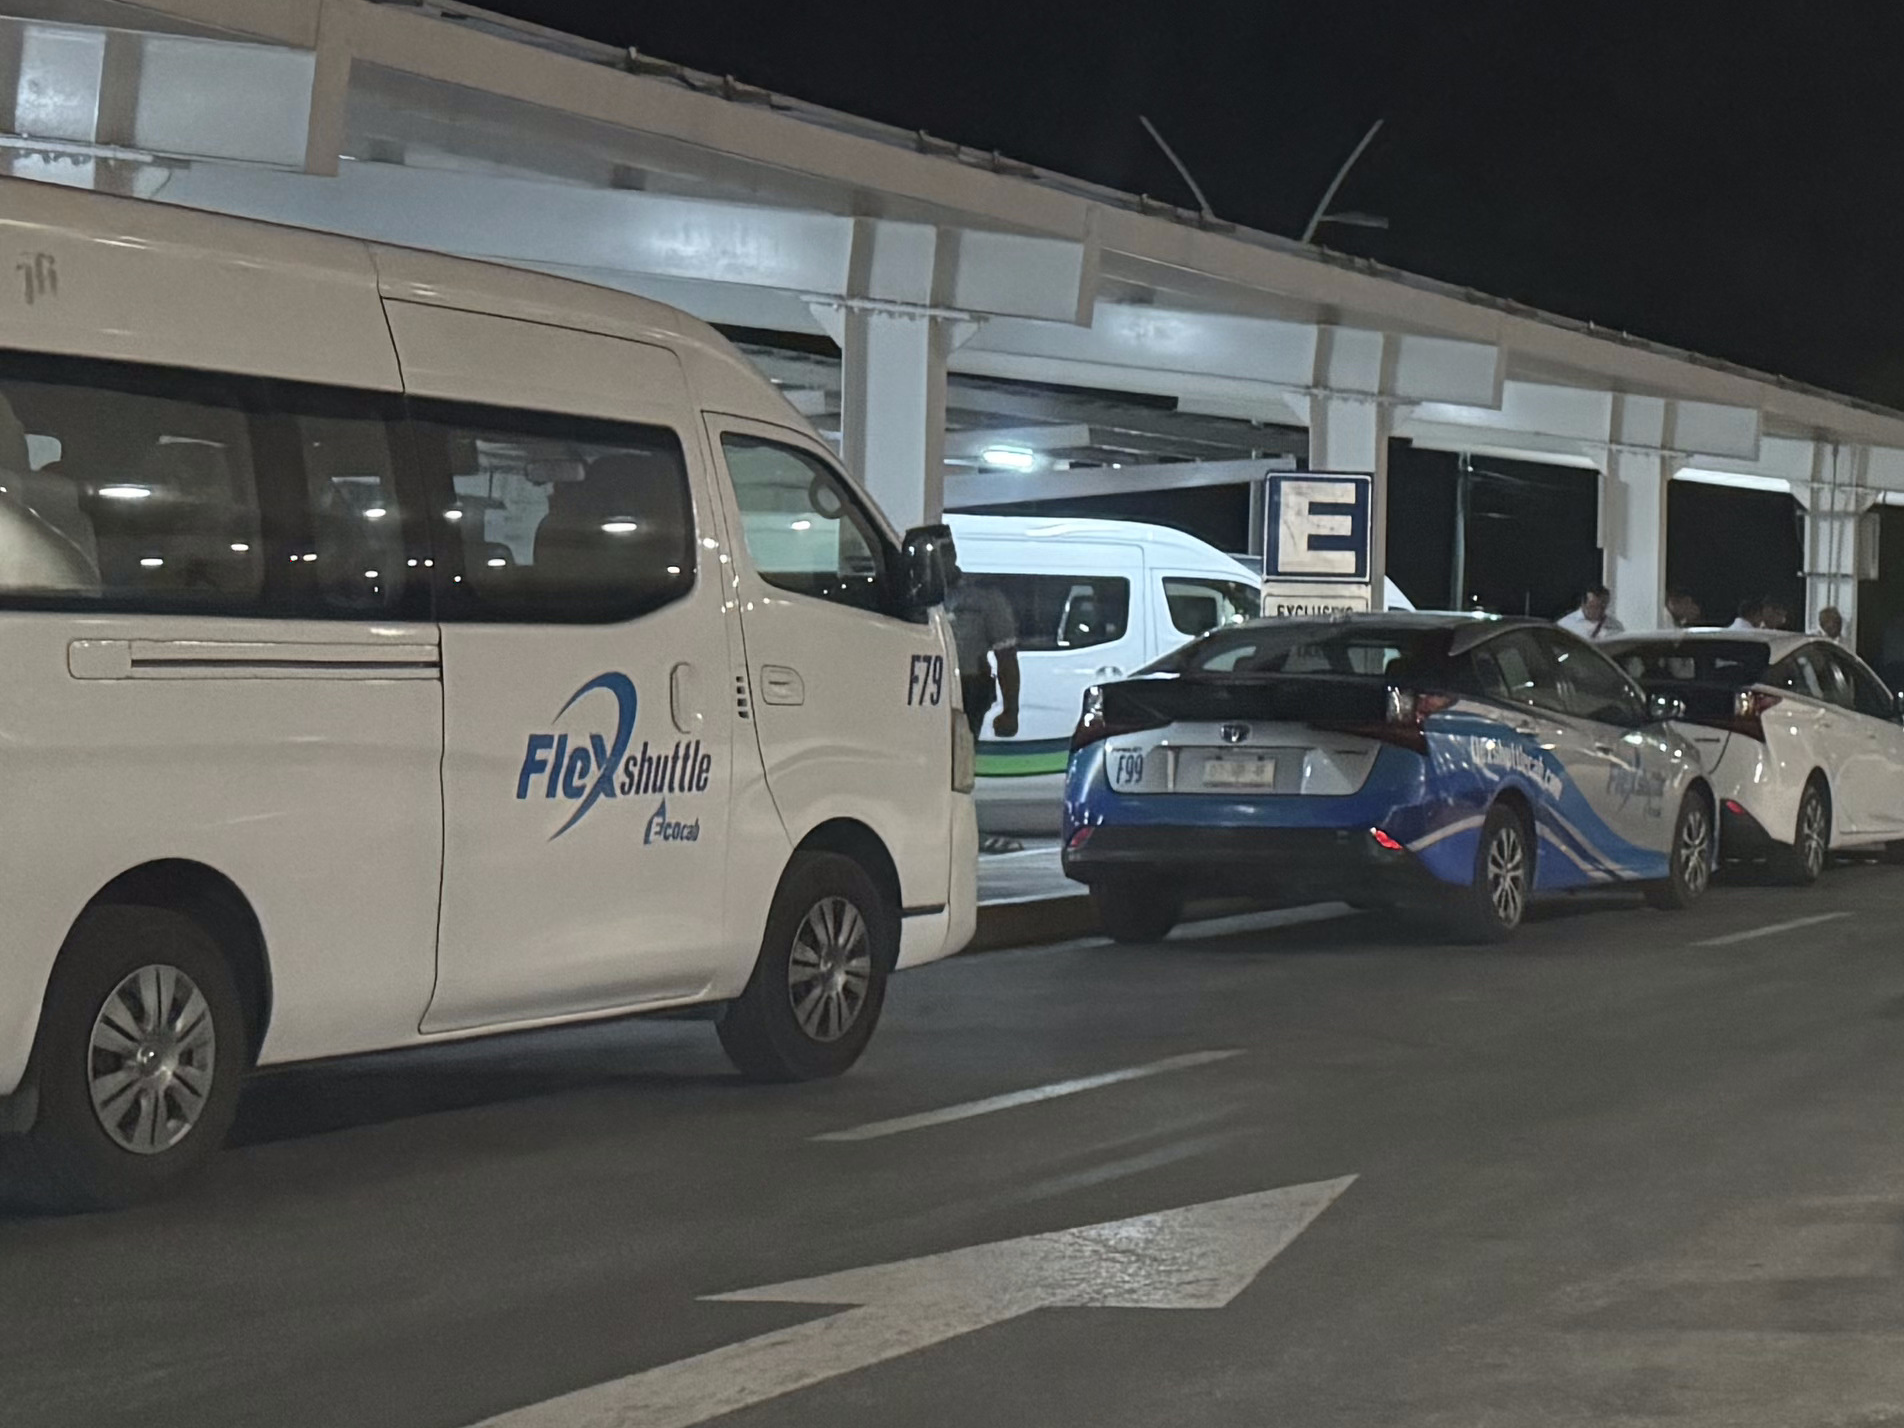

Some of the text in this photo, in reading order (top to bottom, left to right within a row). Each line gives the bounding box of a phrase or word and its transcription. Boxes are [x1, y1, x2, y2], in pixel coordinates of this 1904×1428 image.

[1278, 481, 1356, 573] E
[908, 655, 943, 706] F79
[1116, 754, 1143, 784] F99
